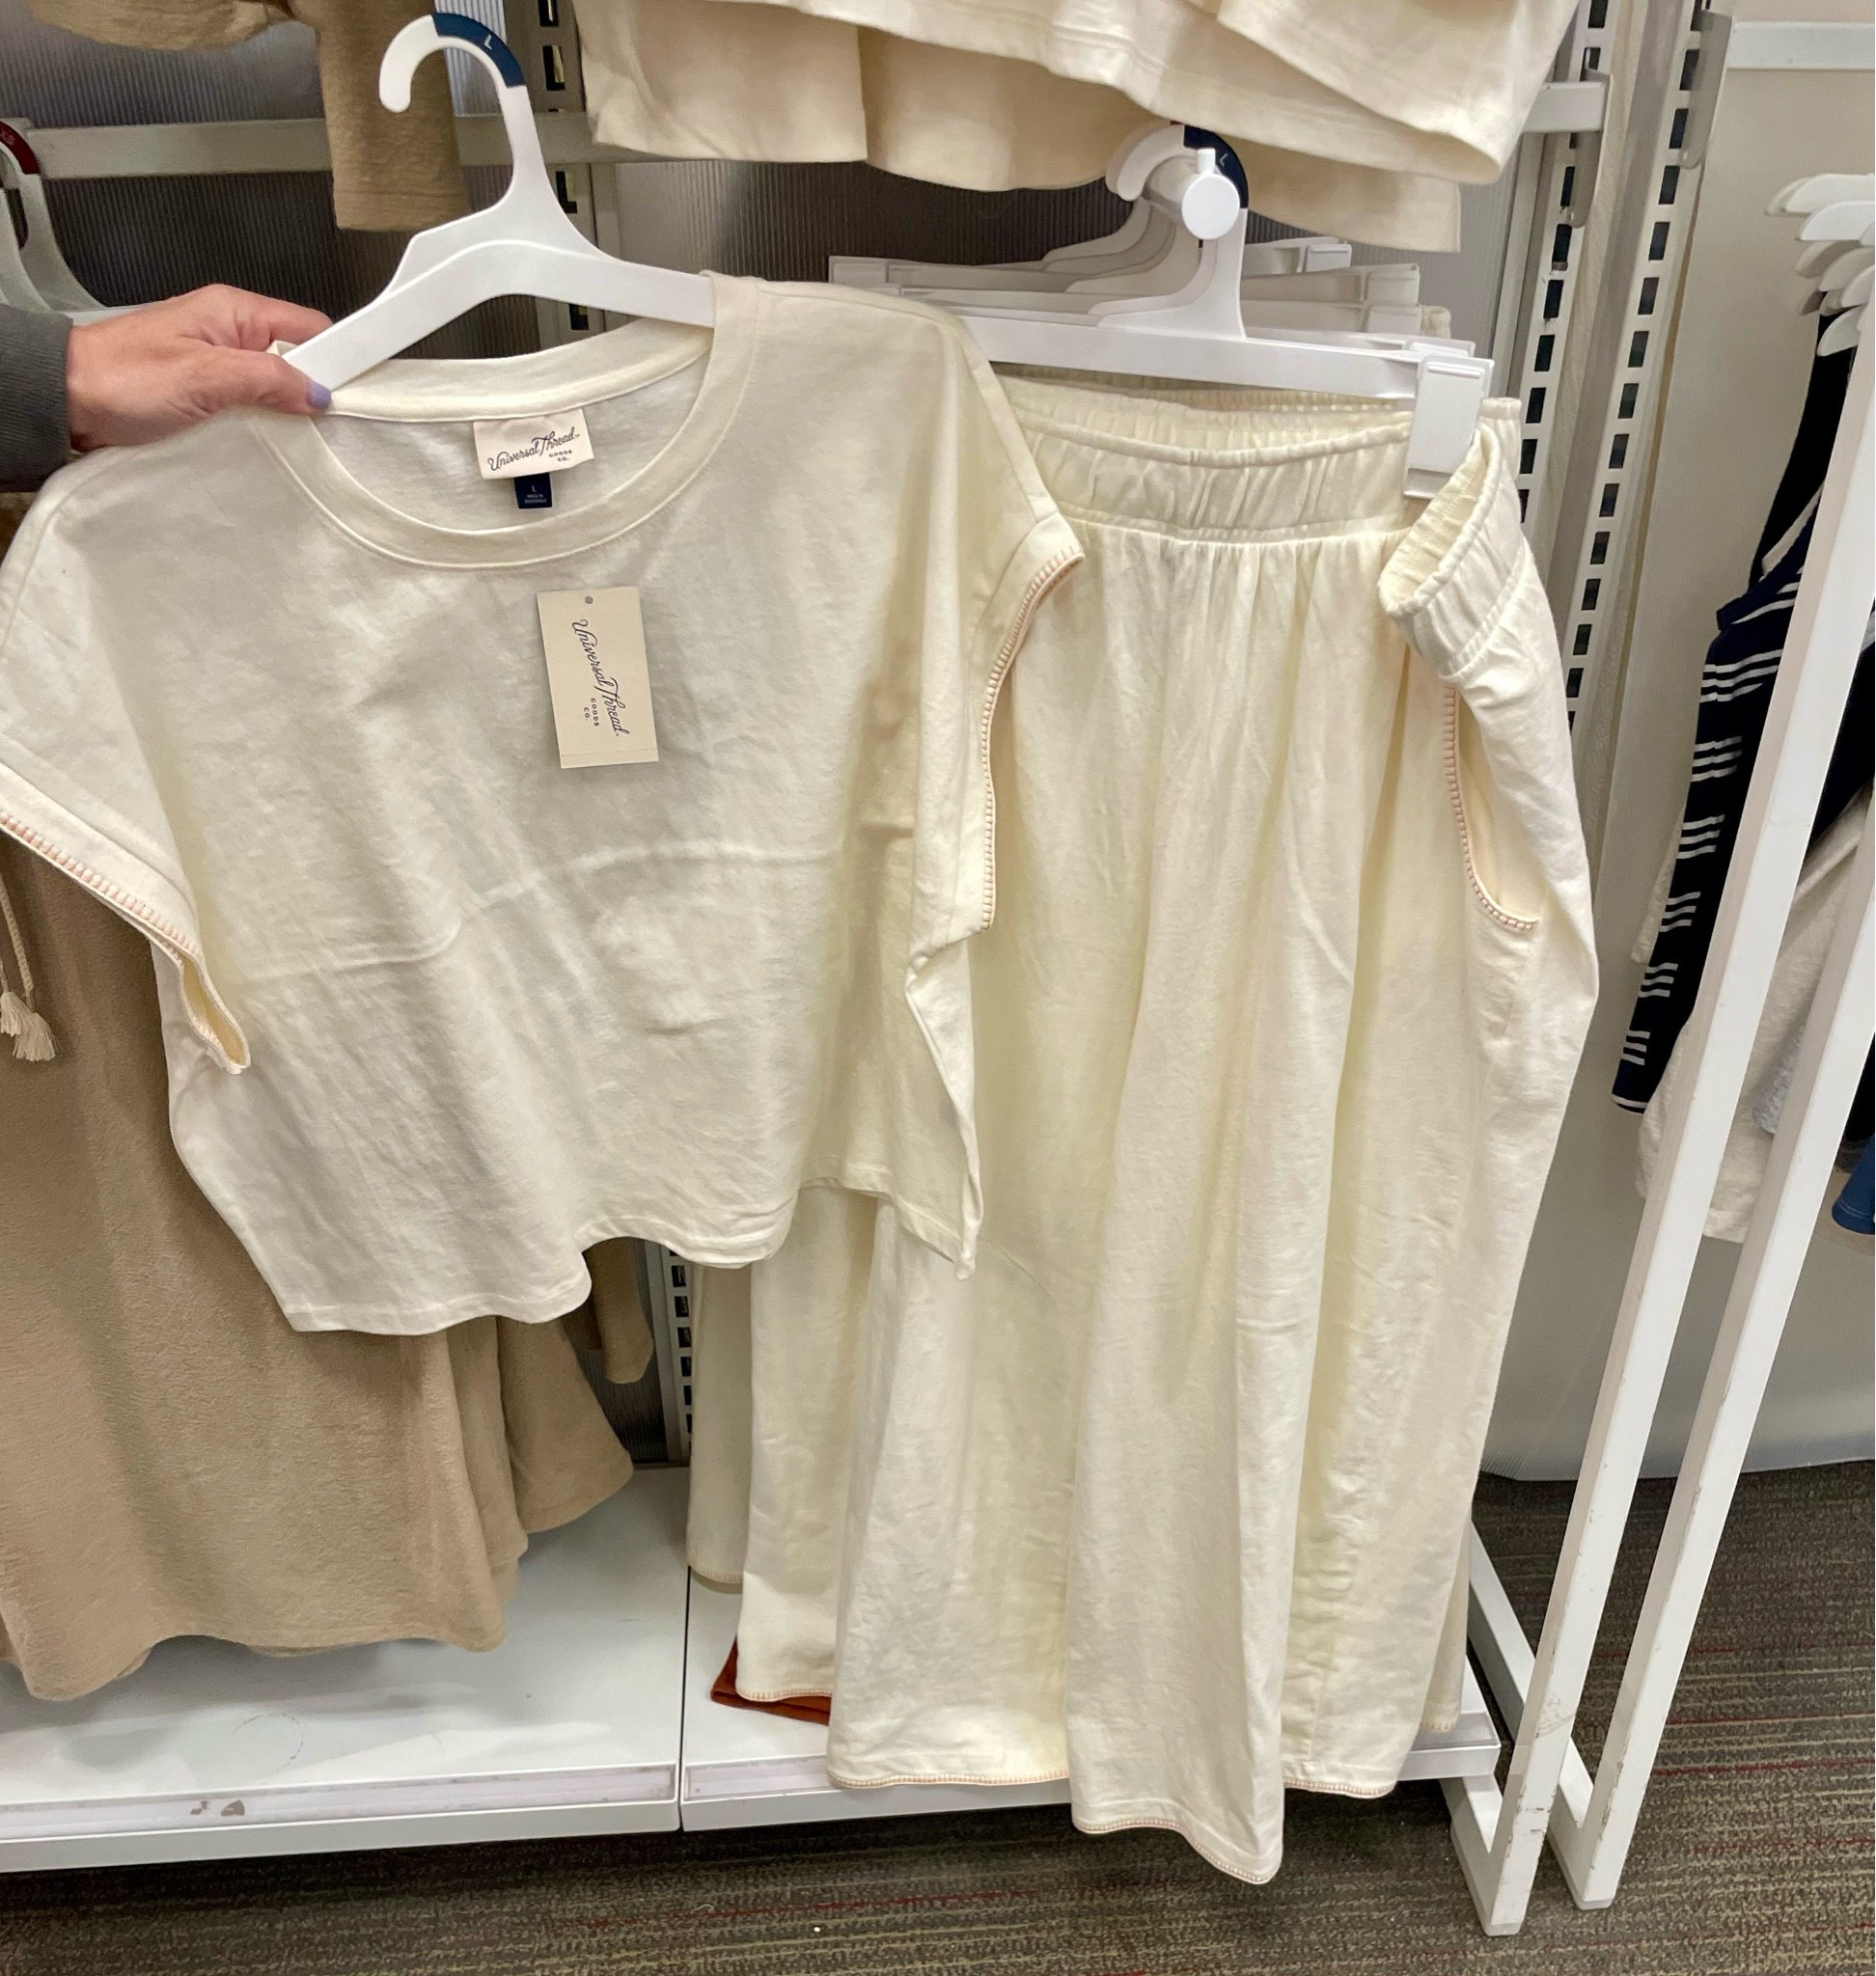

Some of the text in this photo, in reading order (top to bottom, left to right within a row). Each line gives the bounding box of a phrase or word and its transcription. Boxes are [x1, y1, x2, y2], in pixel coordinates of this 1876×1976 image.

[484, 34, 493, 50] L
[1219, 152, 1228, 167] L
[487, 426, 576, 471] Universal Thread
[571, 618, 630, 735] Universal Thread
[591, 698, 600, 727] GOODS
